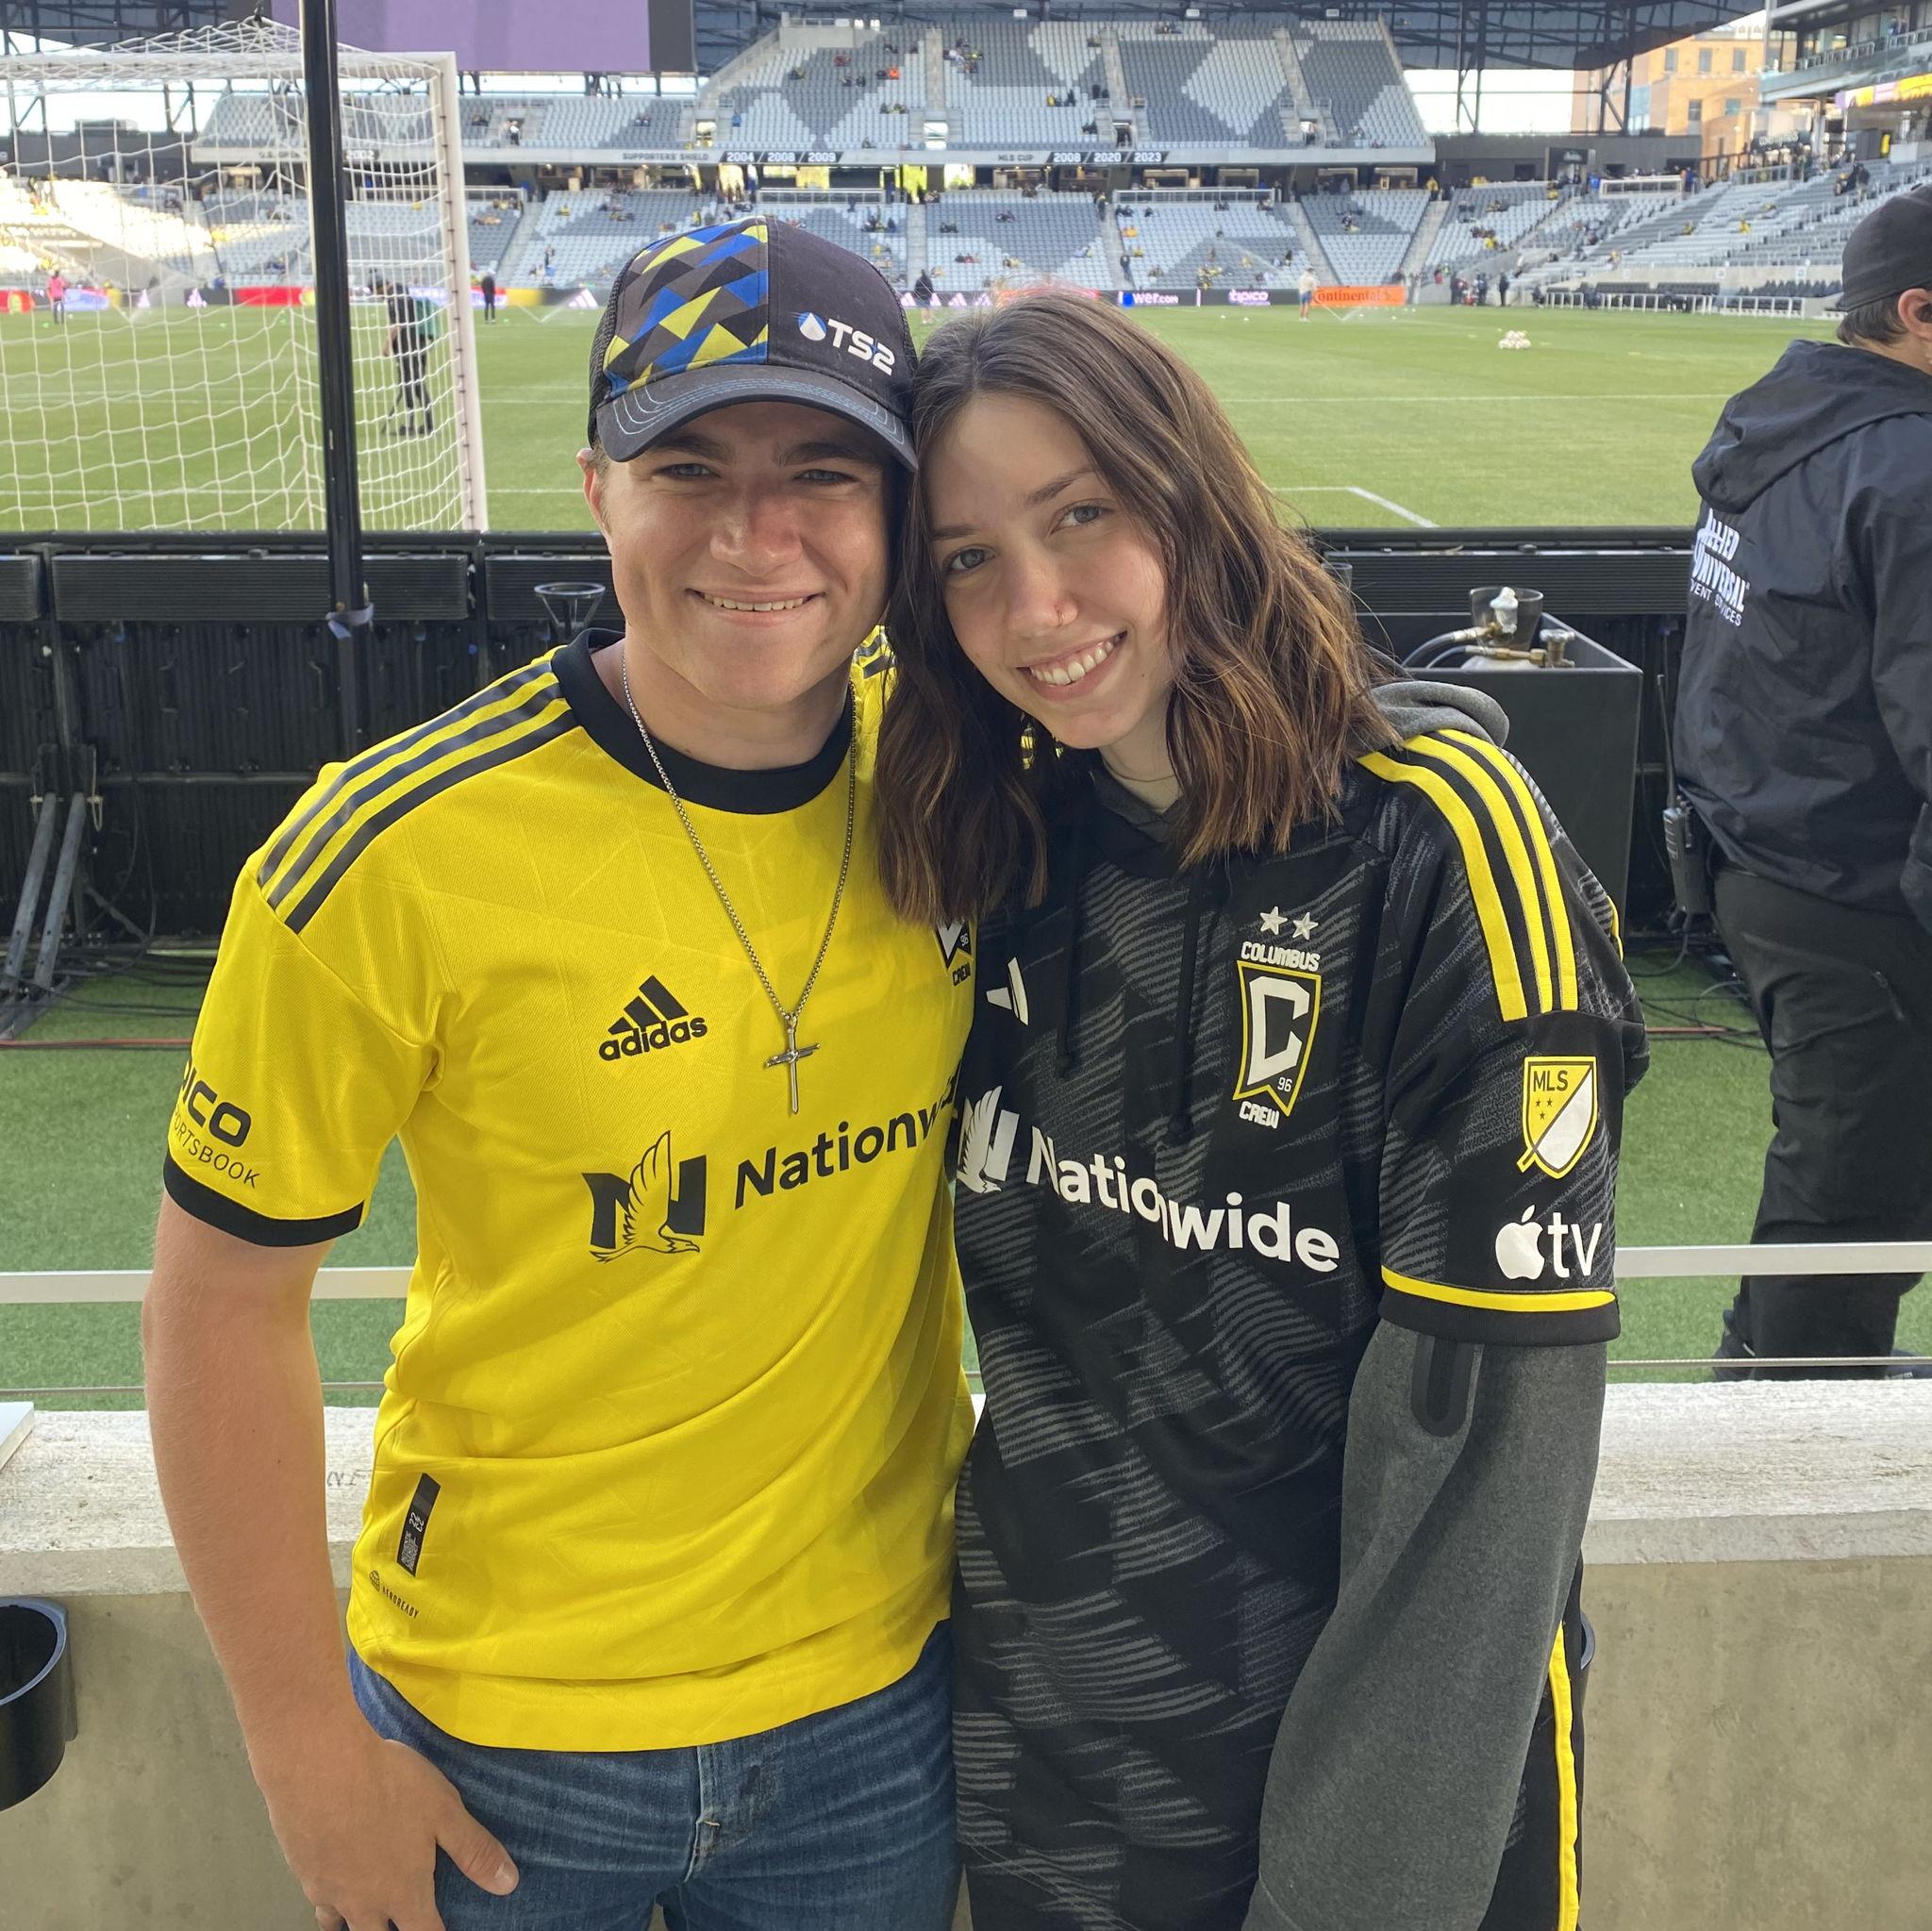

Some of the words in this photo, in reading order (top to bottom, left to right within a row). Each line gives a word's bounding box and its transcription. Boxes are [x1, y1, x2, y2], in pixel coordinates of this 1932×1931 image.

[726, 152, 755, 162] 2004
[767, 152, 795, 162] 2008
[808, 152, 836, 162] 2009
[1053, 152, 1081, 162] 2008
[1093, 152, 1122, 163] 2020
[1134, 152, 1162, 162] 2023
[827, 318, 895, 376] TS2
[1690, 577, 1713, 601] VENT
[1241, 941, 1321, 972] COLUMBUS
[599, 1016, 708, 1061] adidas
[1277, 1076, 1293, 1092] 96
[1533, 1070, 1569, 1092] MLS
[1239, 1100, 1280, 1129] CREW
[1547, 1212, 1602, 1278] tv
[382, 1586, 420, 1619] AEROREADY
